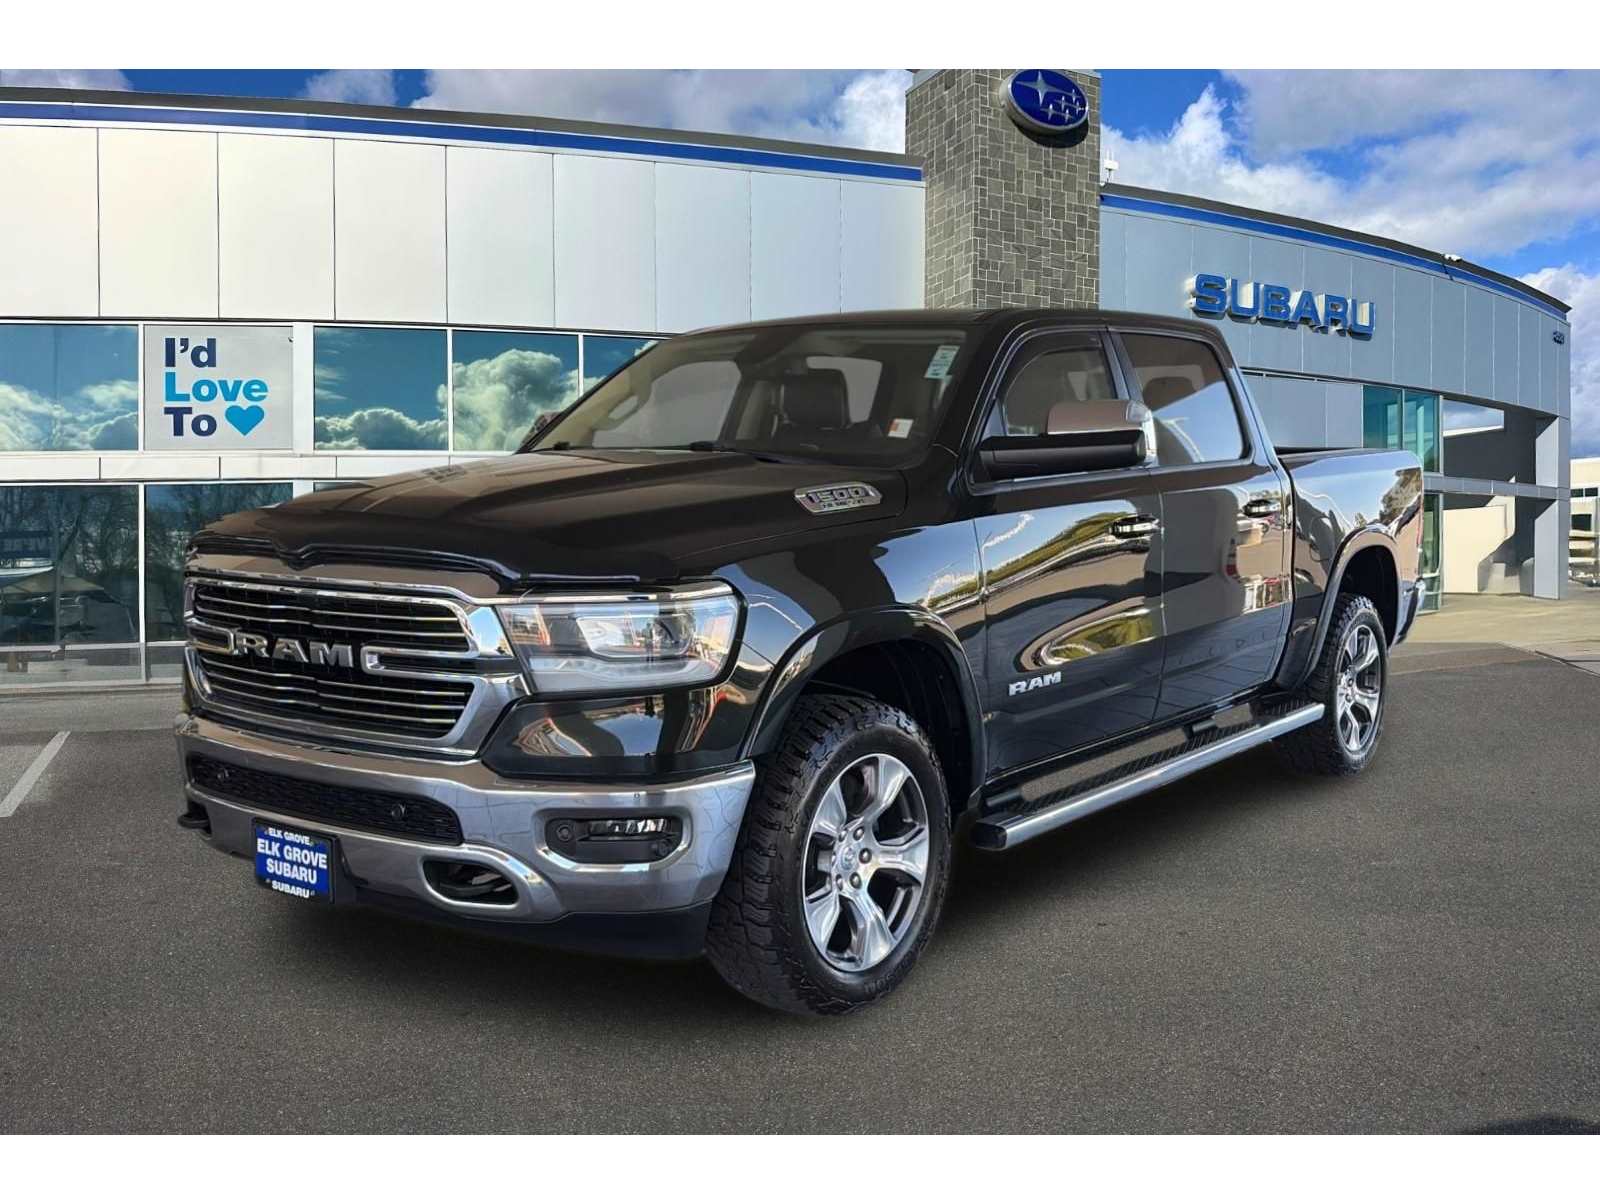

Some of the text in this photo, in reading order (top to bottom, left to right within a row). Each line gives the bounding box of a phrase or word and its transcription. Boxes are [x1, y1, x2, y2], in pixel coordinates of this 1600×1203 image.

[1186, 273, 1376, 340] SUBARU
[164, 337, 217, 368] I'd
[164, 371, 269, 402] Love
[163, 406, 218, 437] To
[235, 631, 354, 668] RAM
[1008, 671, 1062, 697] RAM
[268, 827, 311, 846] ELK GROVE
[256, 838, 328, 870] ELK GROVE
[266, 858, 318, 885] SUBARU
[271, 880, 310, 899] SUBARU
